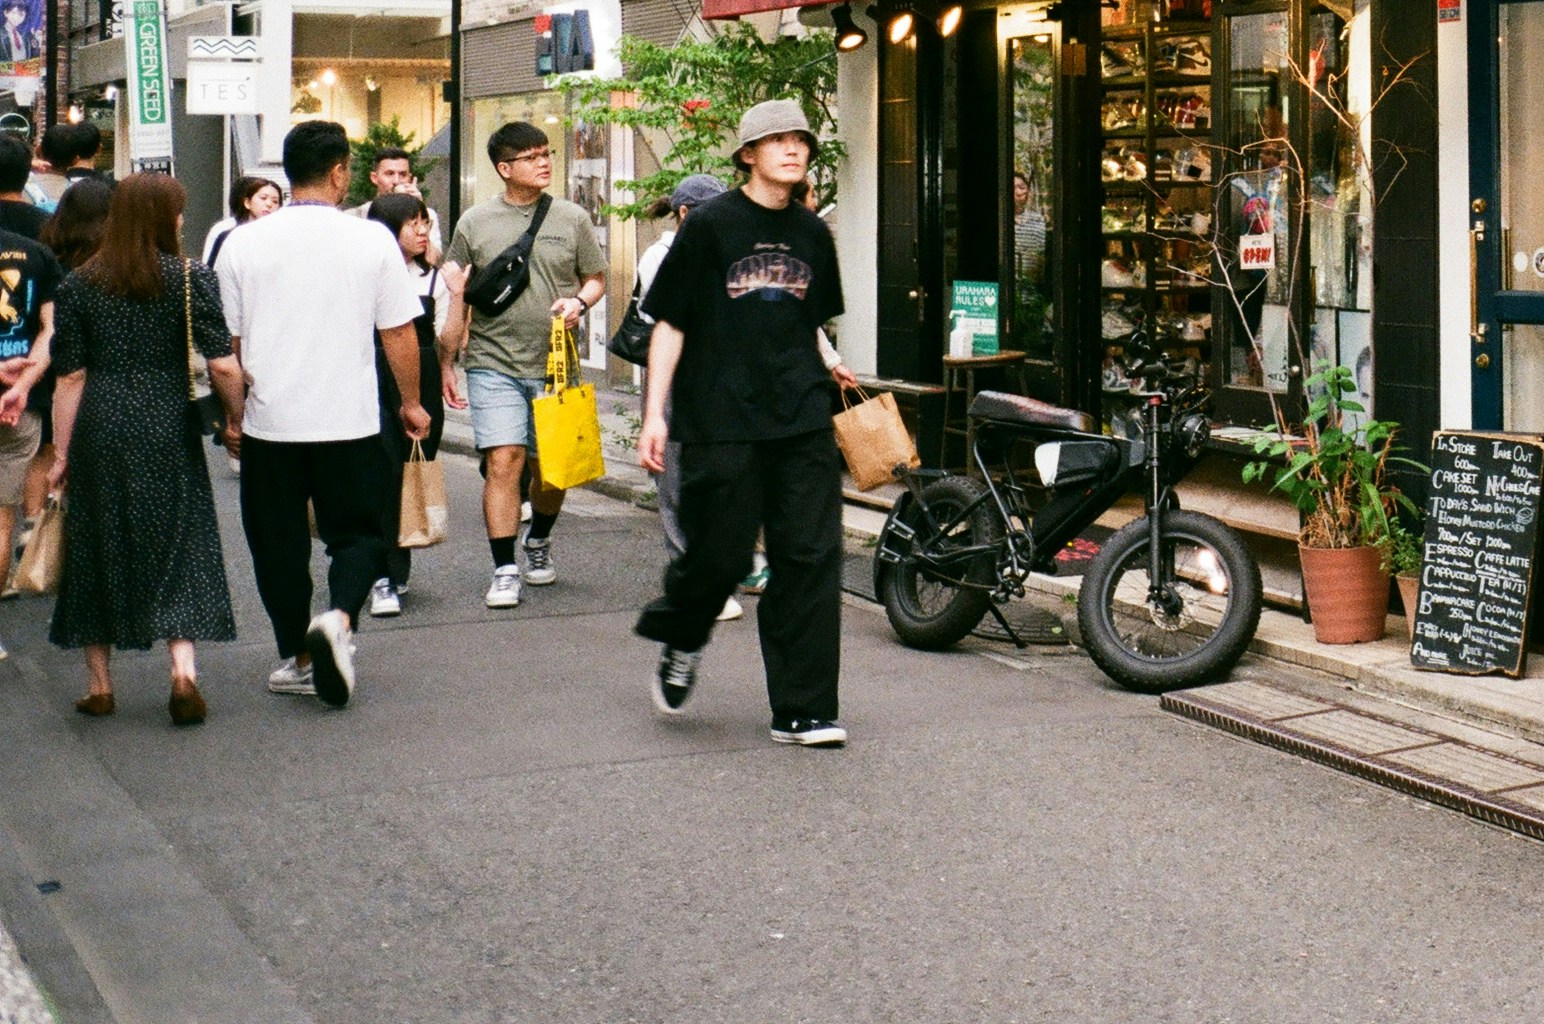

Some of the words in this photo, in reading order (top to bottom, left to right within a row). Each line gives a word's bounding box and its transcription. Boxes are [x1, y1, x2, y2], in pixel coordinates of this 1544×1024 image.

[140, 22, 158, 77] GREEN
[143, 79, 161, 122] SEED
[955, 285, 997, 296] URAHARA
[955, 295, 985, 306] RULES
